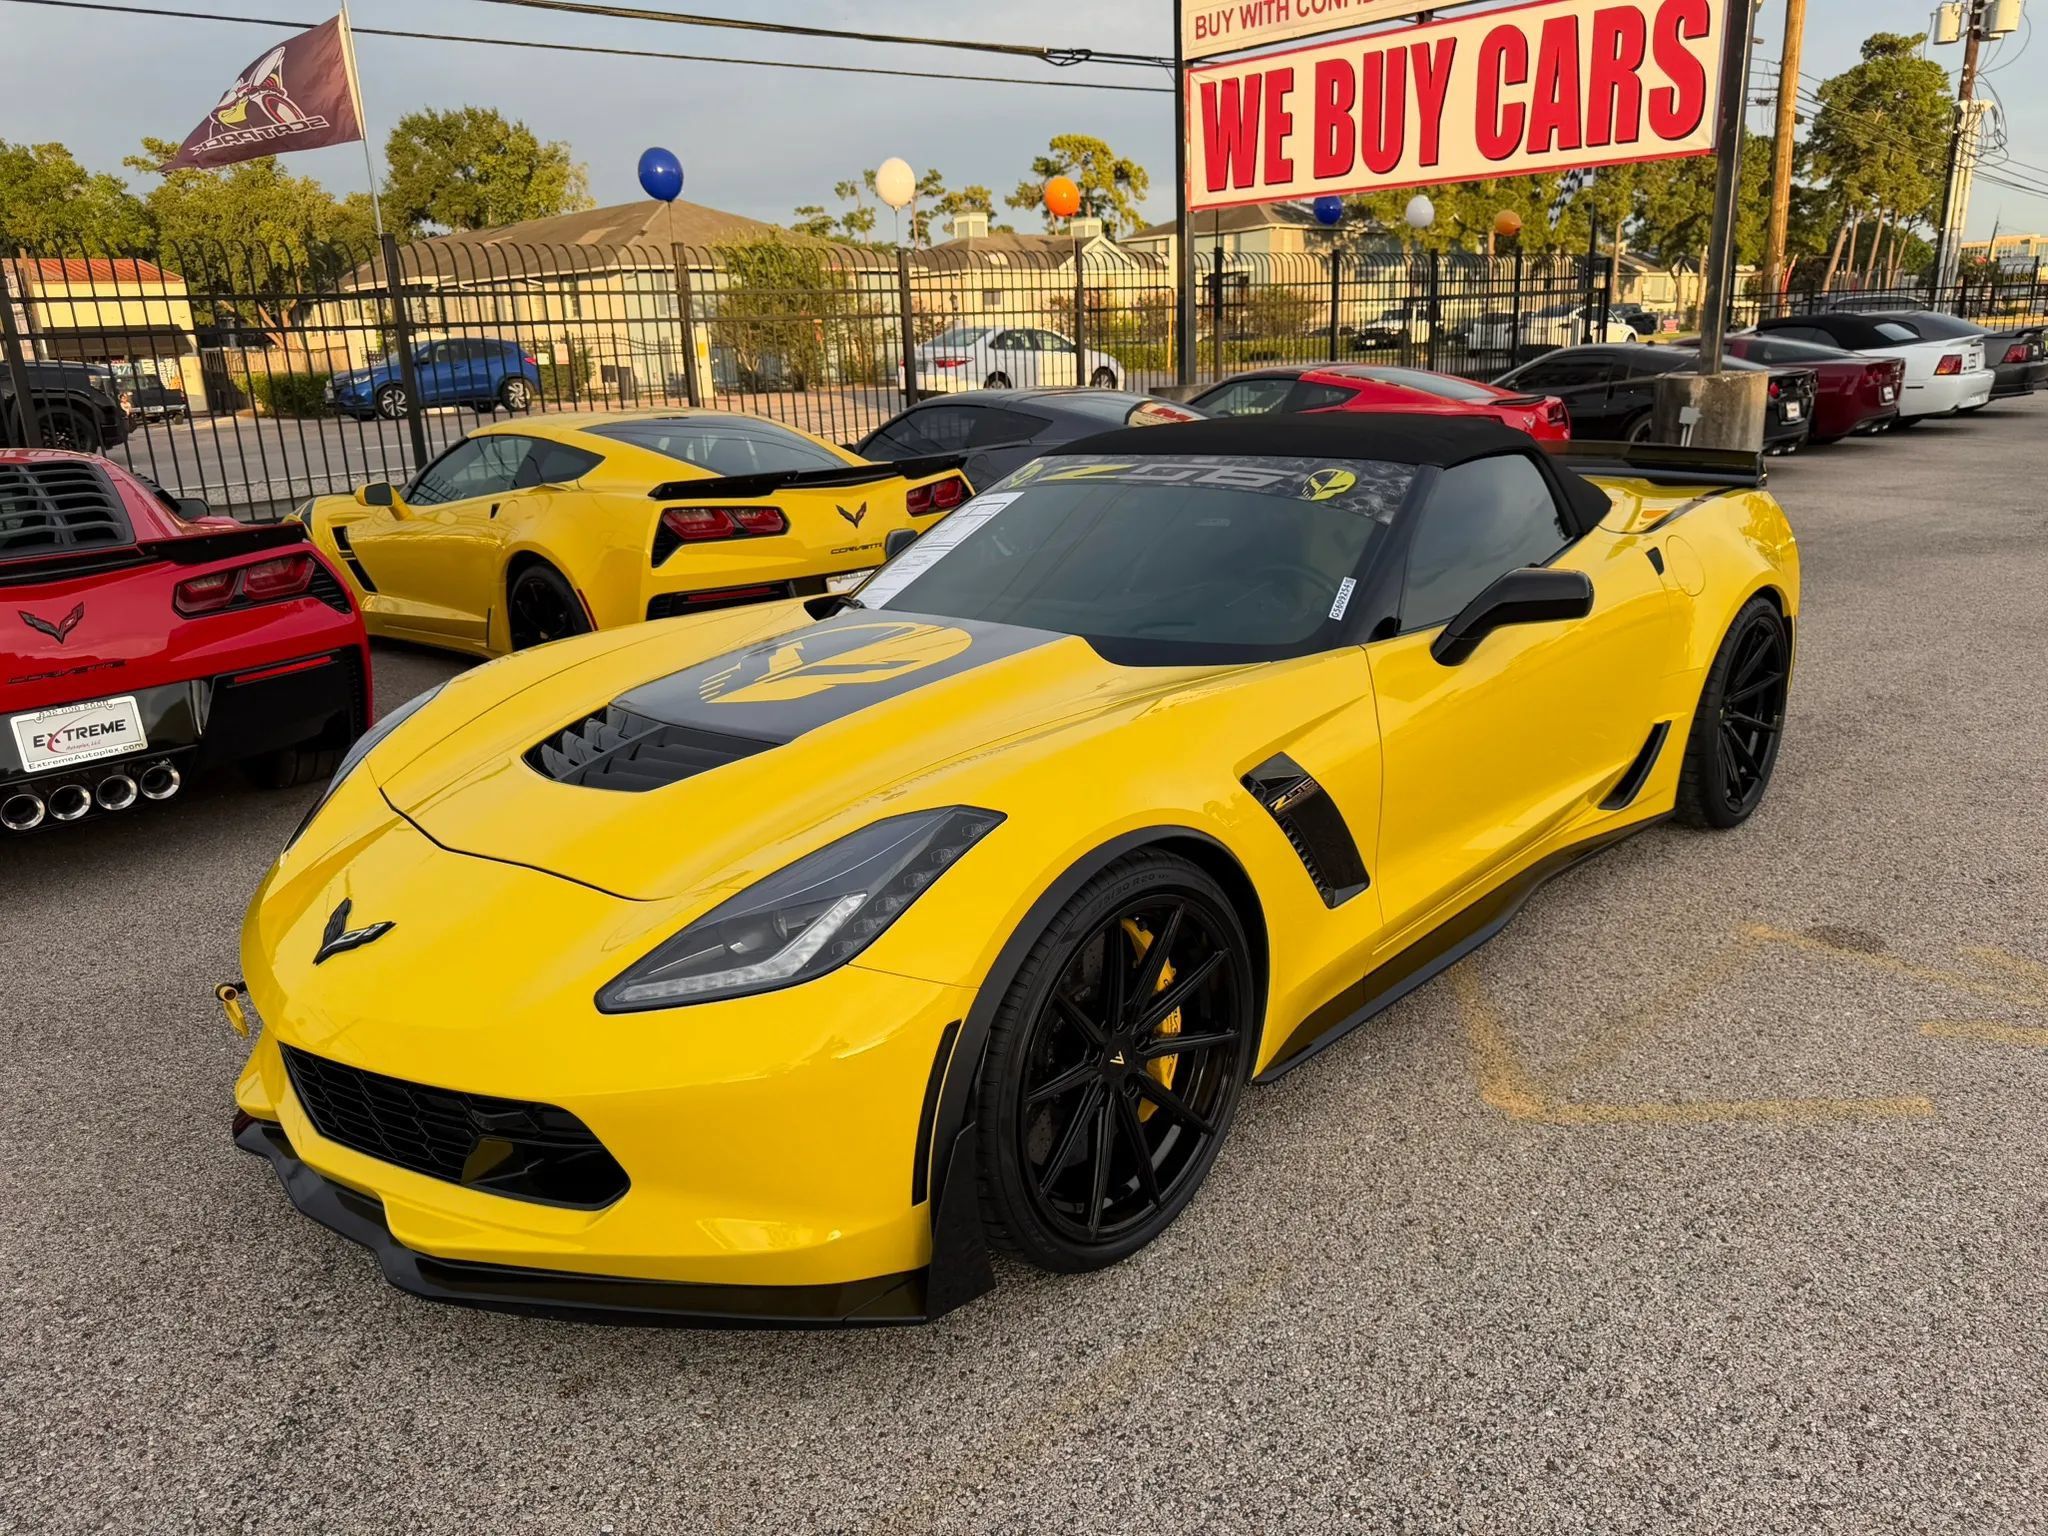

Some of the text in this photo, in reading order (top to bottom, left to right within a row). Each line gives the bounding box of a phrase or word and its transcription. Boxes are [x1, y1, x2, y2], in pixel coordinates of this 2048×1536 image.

[1195, 8, 1234, 40] BUY
[1239, 0, 1290, 30] WITH
[1200, 0, 1710, 192] WE BUY CARS
[1033, 462, 1300, 487] Z06
[33, 719, 126, 748] EXTREME
[28, 742, 144, 770] ExtremeAutoplex.com
